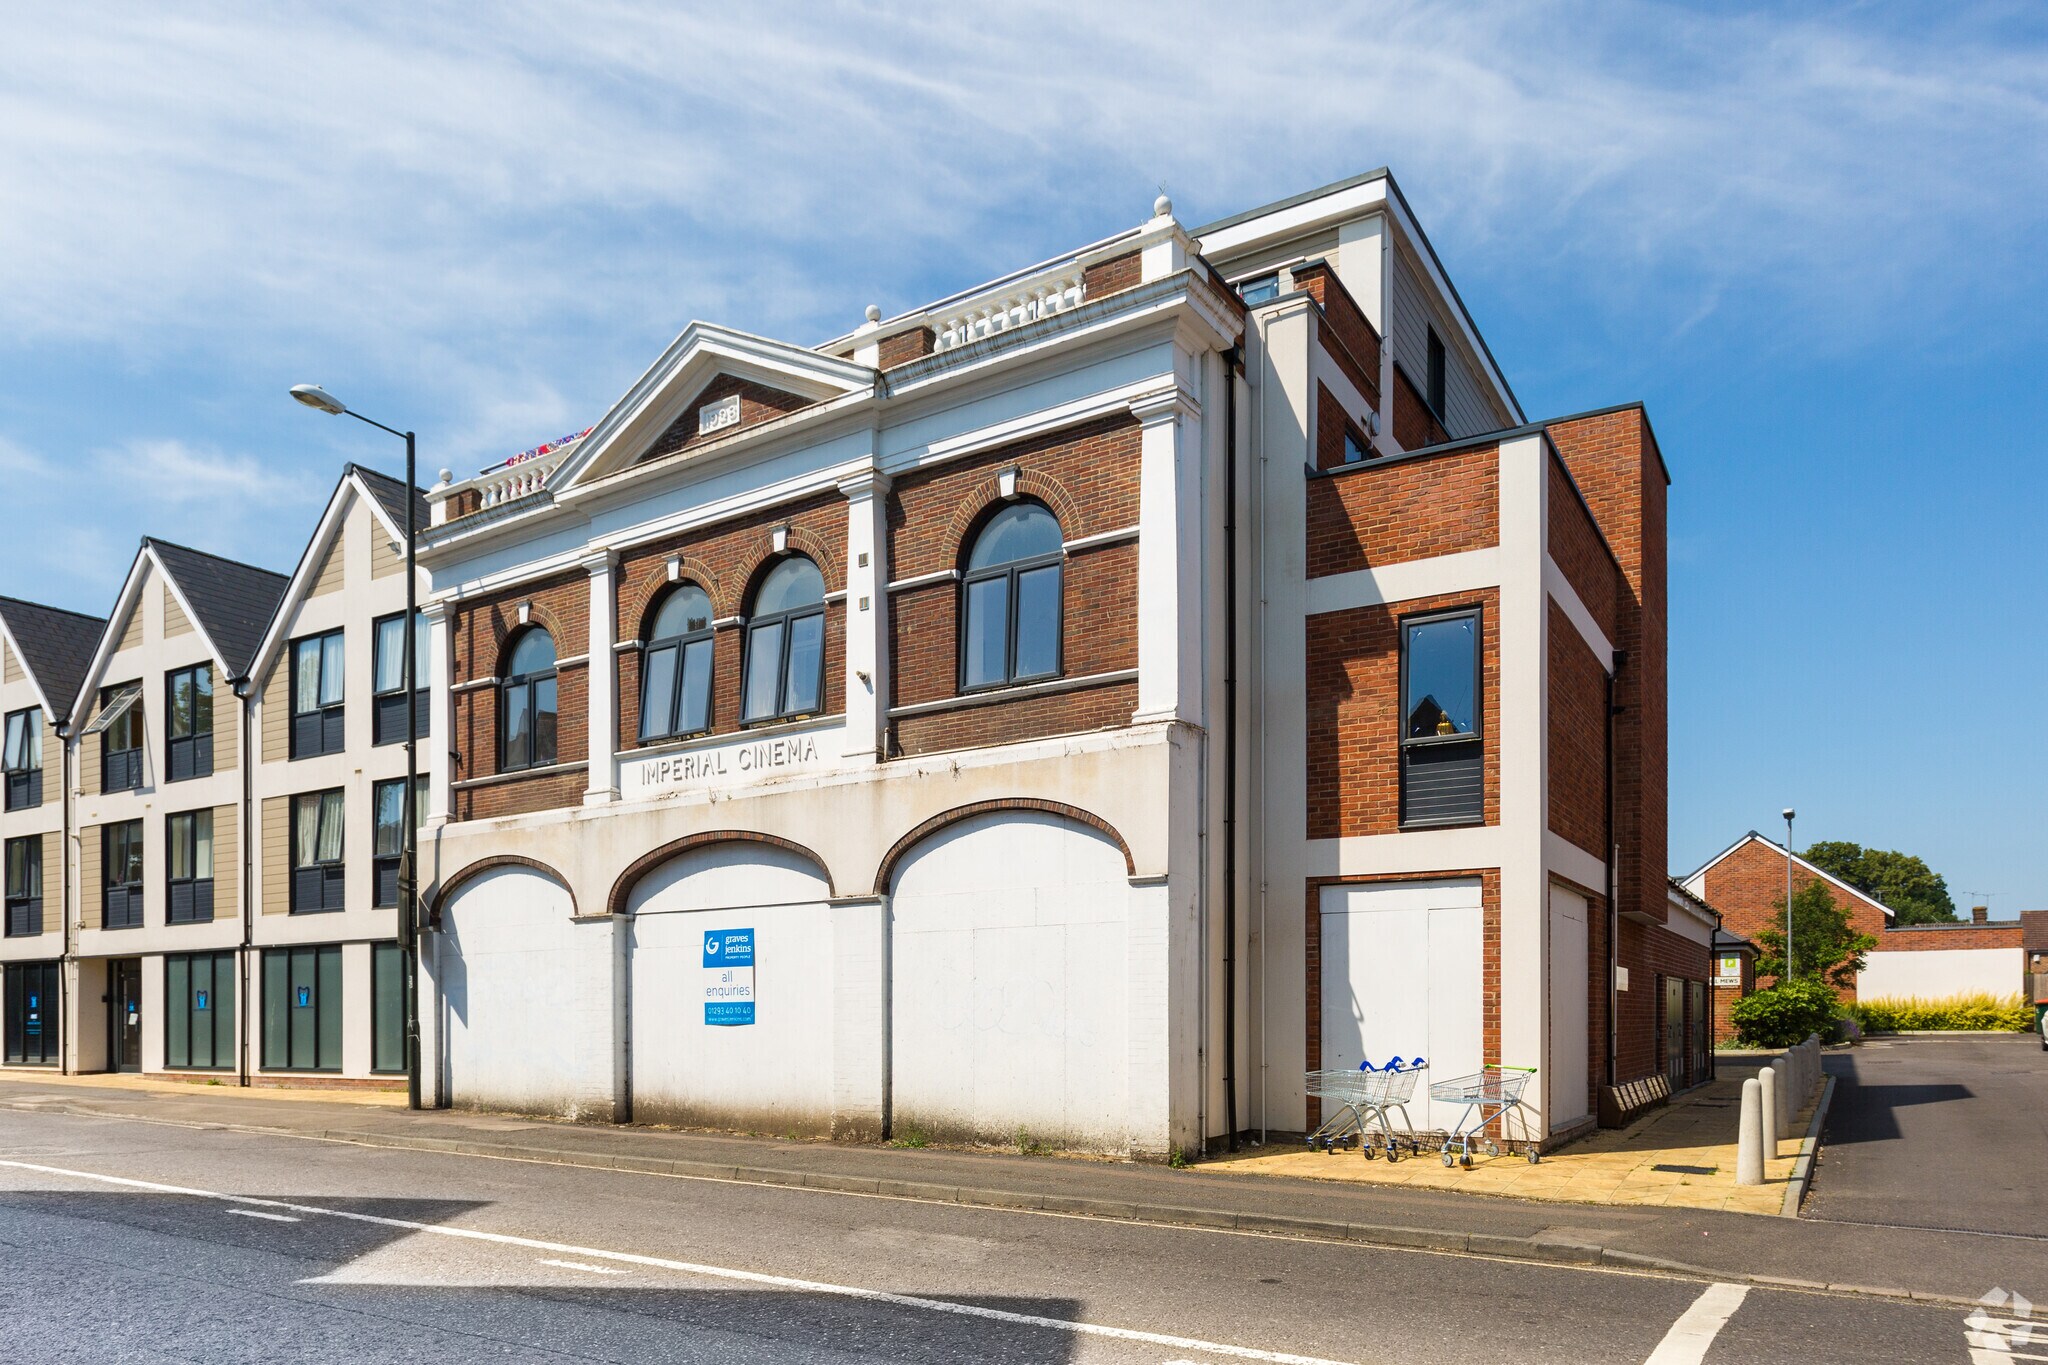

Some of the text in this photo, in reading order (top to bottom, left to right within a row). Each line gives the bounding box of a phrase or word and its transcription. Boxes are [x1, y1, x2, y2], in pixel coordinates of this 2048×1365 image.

[642, 736, 818, 785] IMPERIAL CINEMA
[725, 935, 749, 944] graves
[725, 944, 751, 955] jenkins
[722, 971, 733, 982] all
[706, 985, 750, 998] enquiries
[708, 1006, 751, 1015] 01293 40 10 40
